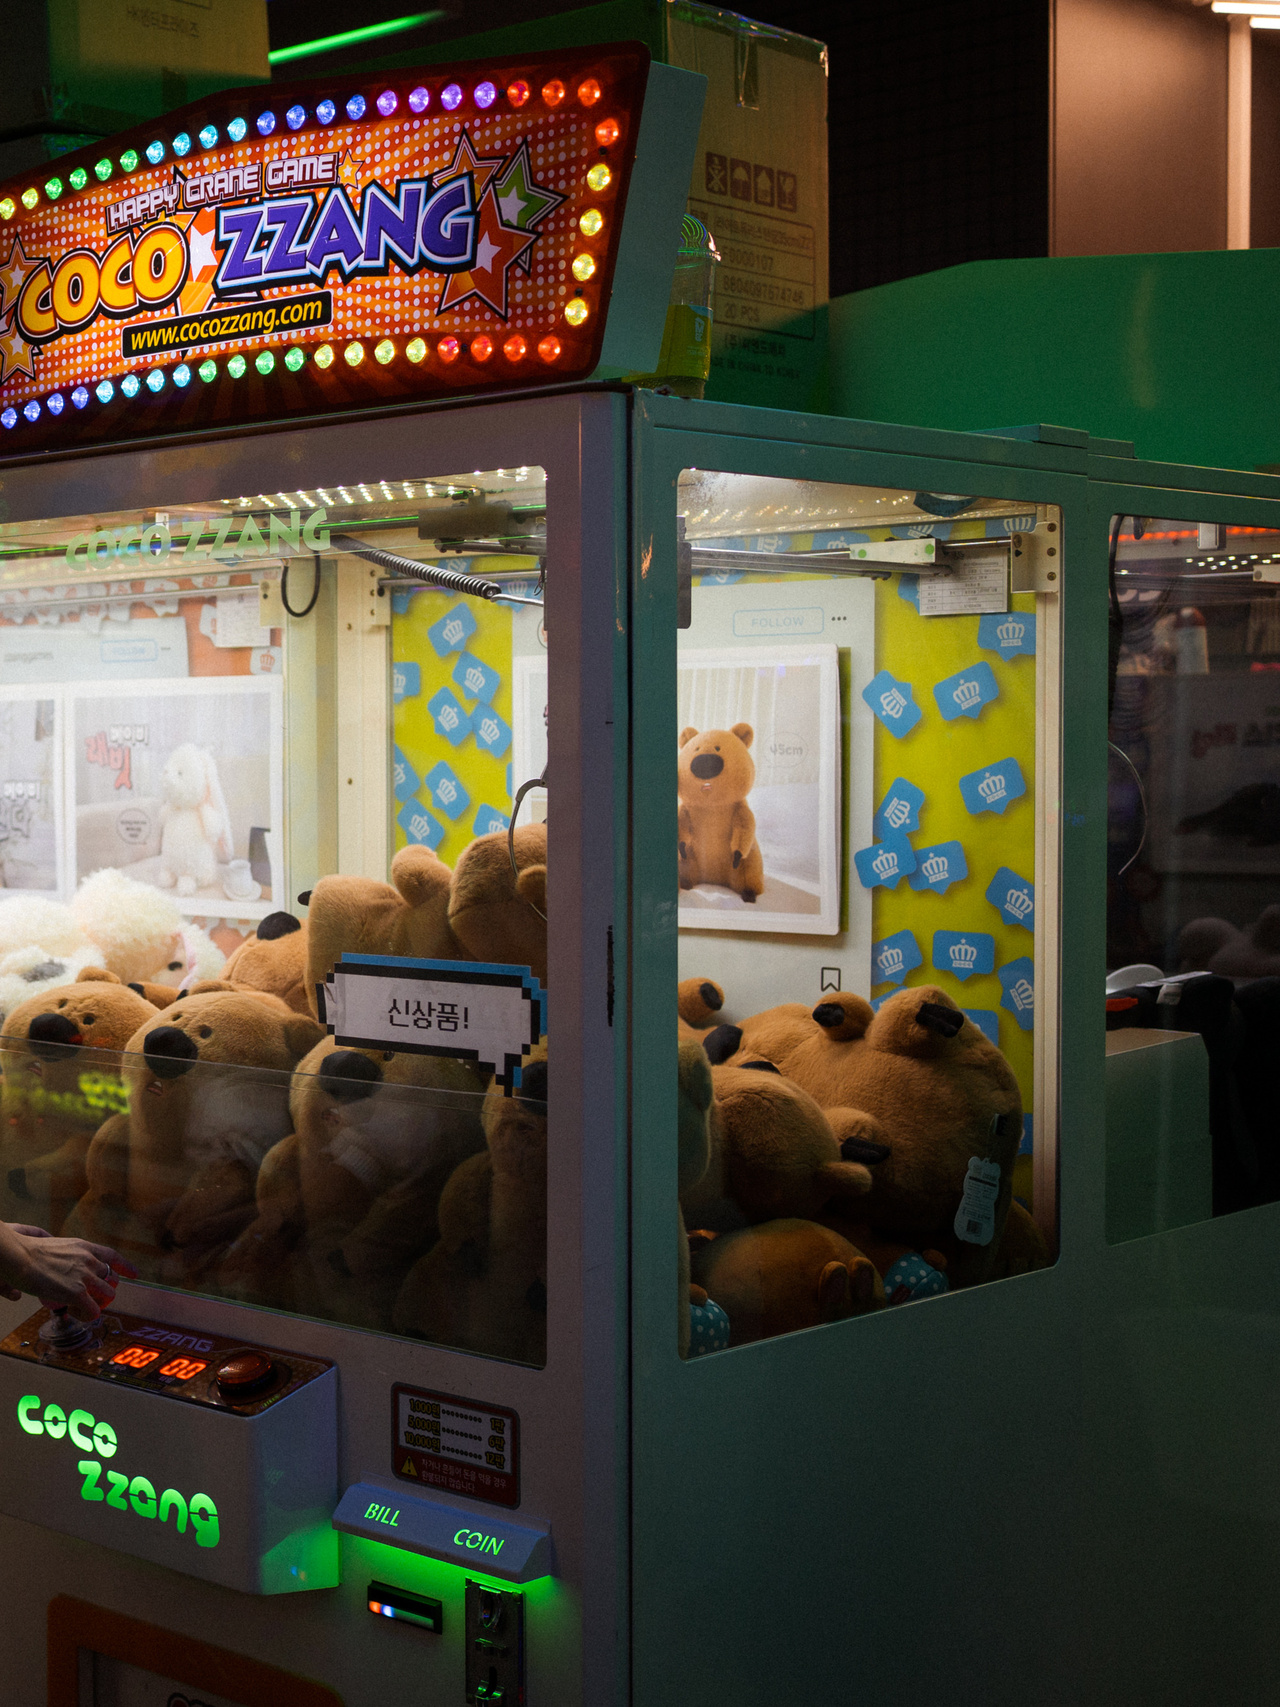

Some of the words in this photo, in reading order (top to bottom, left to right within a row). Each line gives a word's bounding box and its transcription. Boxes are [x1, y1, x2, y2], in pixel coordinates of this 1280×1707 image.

[106, 184, 178, 232] HAPPY
[184, 164, 262, 205] CRANE
[266, 152, 337, 190] GAME
[17, 228, 188, 337] COCO
[216, 172, 477, 291] ZZANG
[130, 297, 323, 351] www.cocozzang.com
[65, 524, 172, 571] COCO
[180, 507, 331, 561] ZZANG
[750, 616, 805, 628] FOLLOW
[769, 743, 804, 758] 45cm
[388, 998, 470, 1032] 신상품!
[113, 1346, 160, 1370] 00
[159, 1357, 207, 1380] 00
[408, 1415, 441, 1436] 5,000원
[488, 1435, 506, 1453] 6판
[409, 1398, 441, 1419] 1,000원
[490, 1417, 506, 1435] 1판
[404, 1431, 441, 1454] 10,000원
[485, 1451, 506, 1470] 12판
[364, 1502, 401, 1527] BILL
[453, 1528, 505, 1556] COIN
